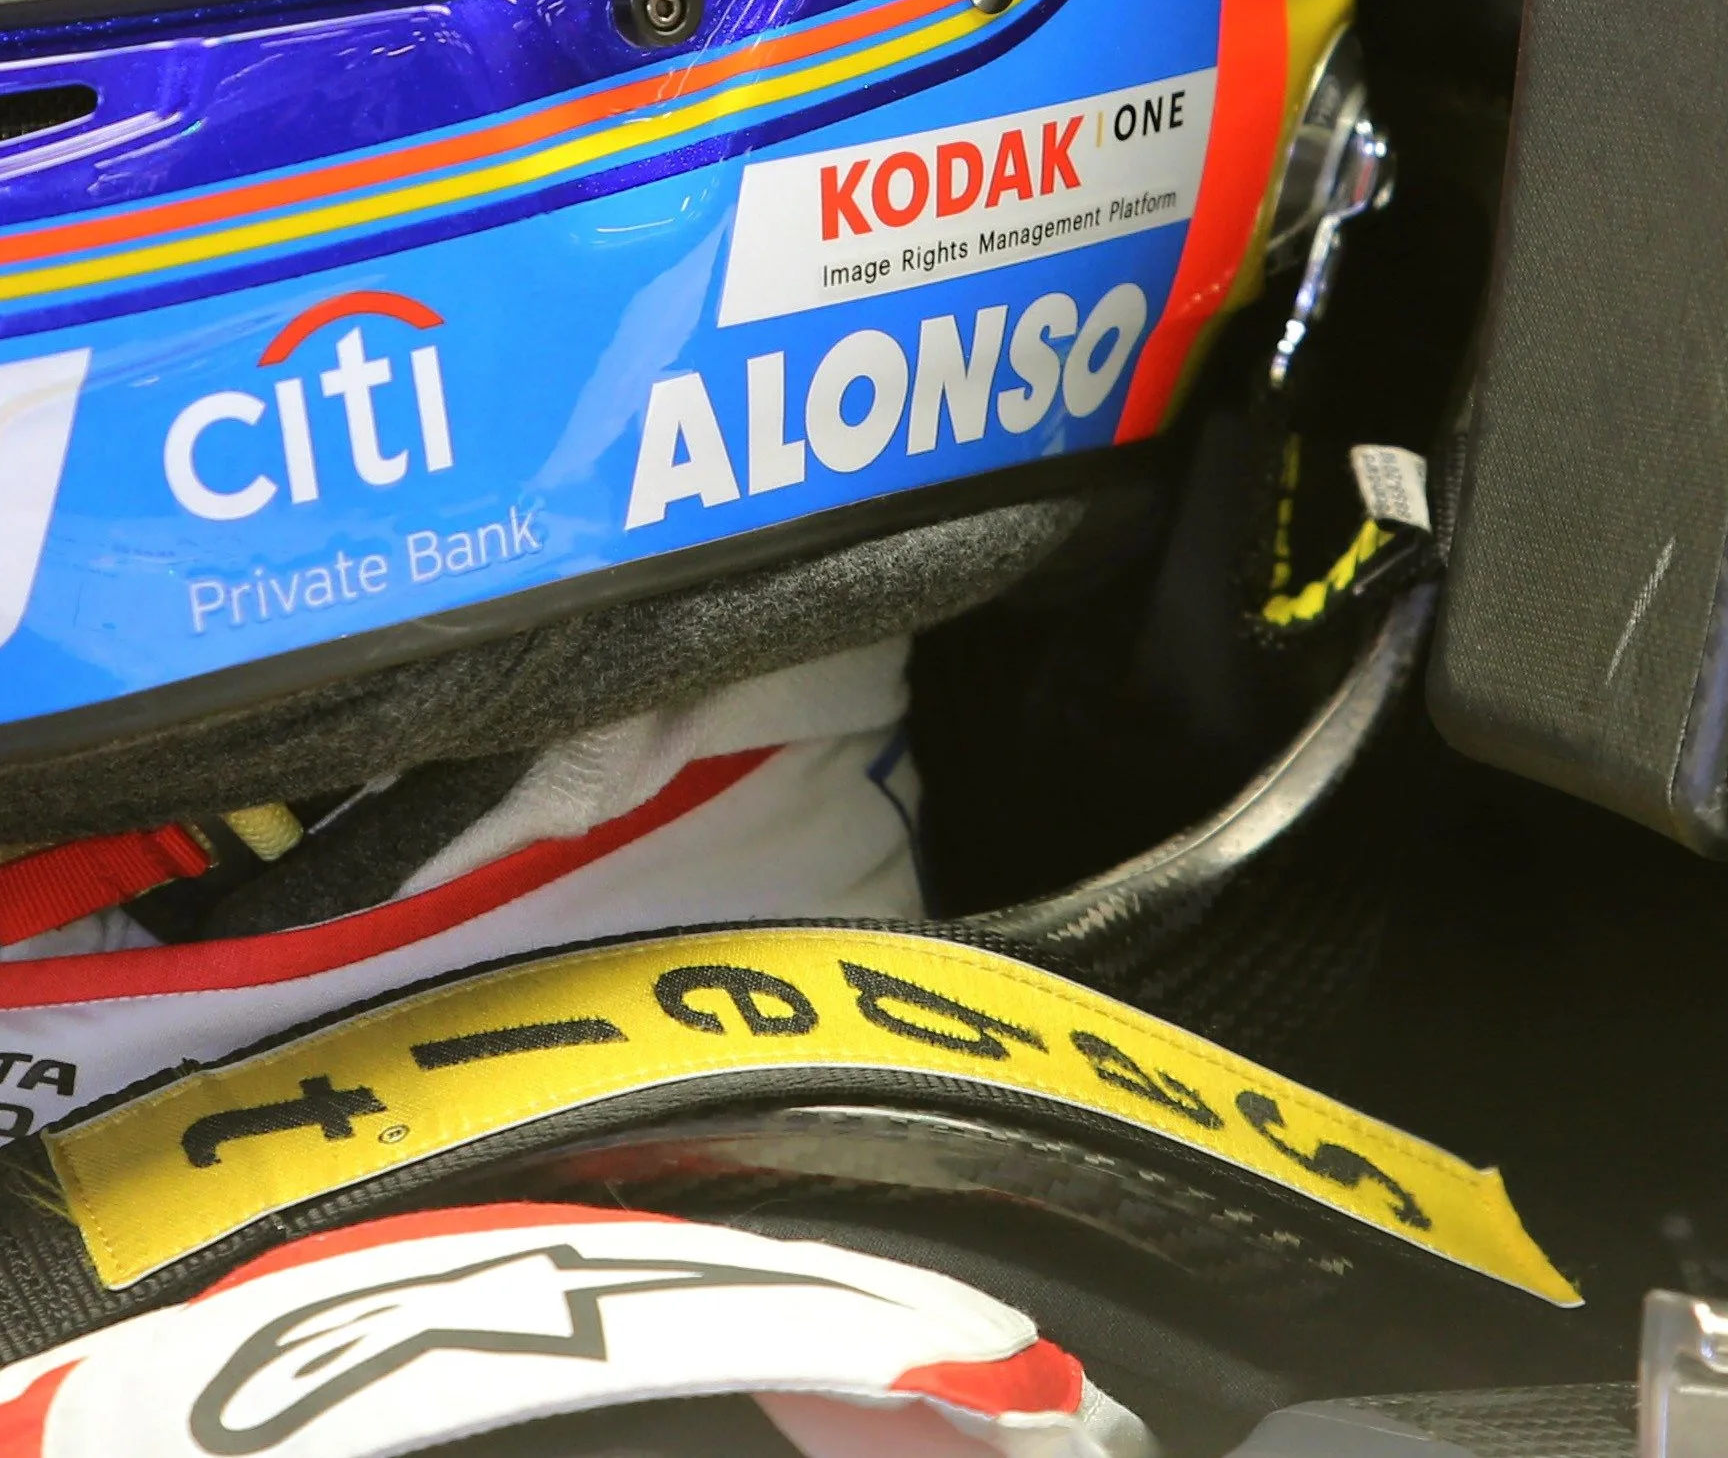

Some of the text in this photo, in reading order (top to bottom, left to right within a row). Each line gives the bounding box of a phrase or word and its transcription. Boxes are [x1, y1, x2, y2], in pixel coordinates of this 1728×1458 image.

[820, 90, 1186, 242] KODAK ONE
[822, 190, 1177, 288] Image Rights Management Platform
[163, 326, 454, 521] citi
[624, 282, 1148, 532] ALONSO
[189, 503, 543, 634] Private Bank
